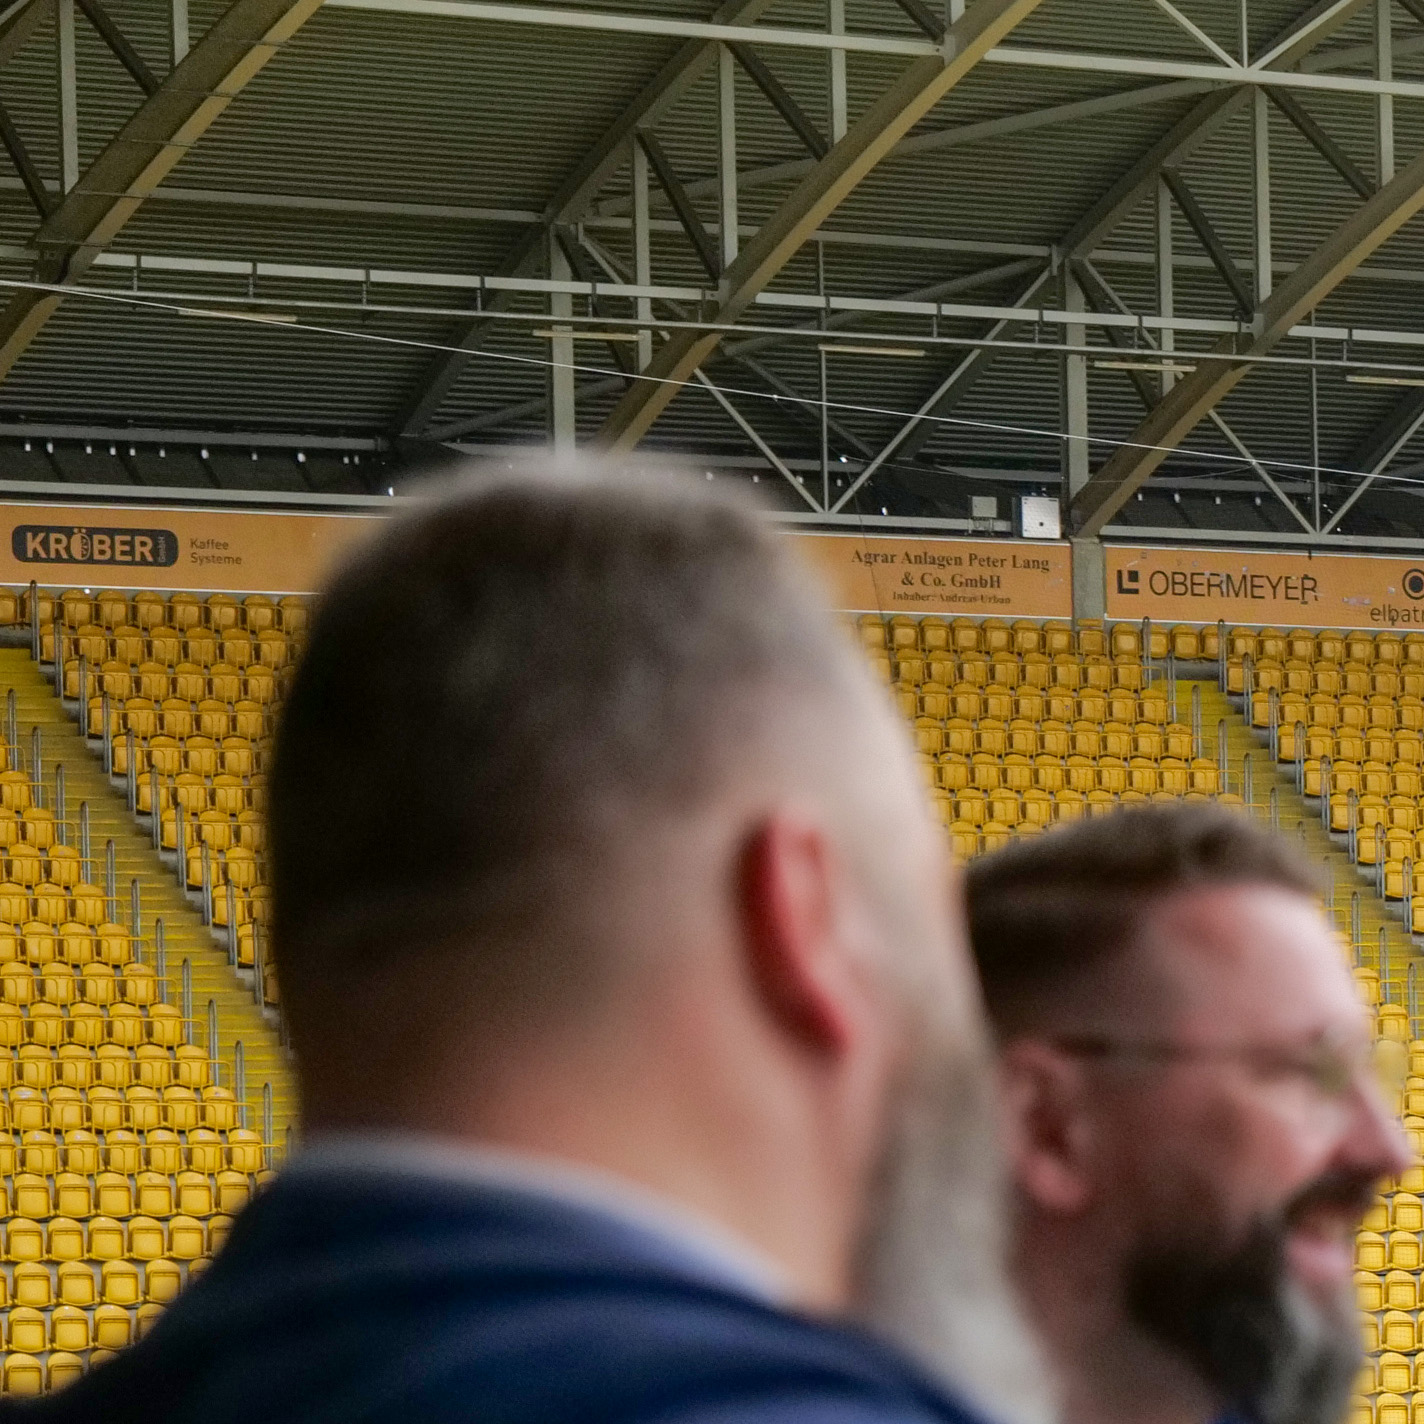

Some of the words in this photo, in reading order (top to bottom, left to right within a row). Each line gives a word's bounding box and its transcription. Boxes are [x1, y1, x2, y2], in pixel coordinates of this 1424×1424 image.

[26, 528, 154, 563] KRÖBER
[190, 538, 230, 551] Kaffee
[190, 553, 242, 566] Systeme
[852, 550, 897, 568] Agrar
[901, 551, 963, 569] Anlagen
[968, 553, 1008, 568] Peter
[1012, 555, 1050, 573] Lang
[901, 572, 914, 586] &
[920, 573, 946, 587] Co.
[951, 574, 1001, 589] GmbH
[1149, 569, 1319, 602] OBERMEYER
